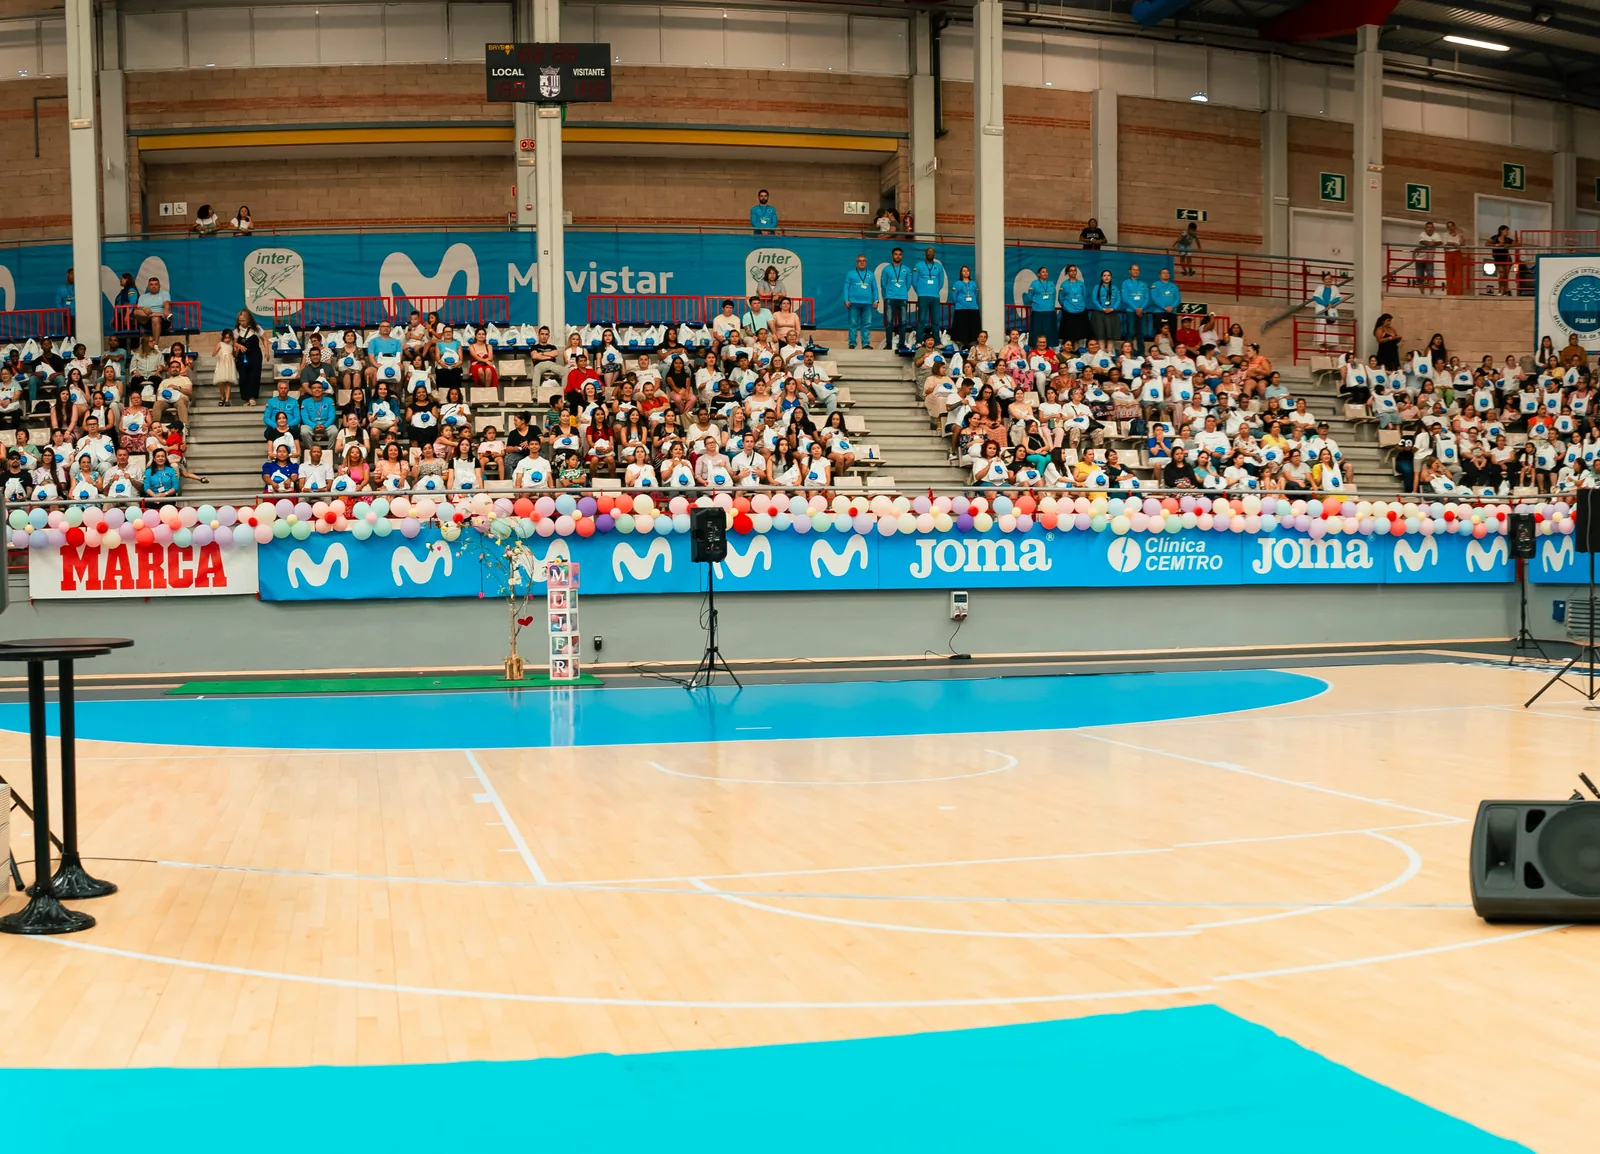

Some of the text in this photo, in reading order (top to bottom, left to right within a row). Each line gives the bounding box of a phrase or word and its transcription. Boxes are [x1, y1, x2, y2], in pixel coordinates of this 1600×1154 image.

[492, 68, 524, 76] LOCAL
[573, 68, 605, 76] VISITANTE
[257, 252, 292, 264] inter
[757, 251, 791, 264] inter
[508, 261, 674, 294] Mvistar
[1145, 536, 1206, 553] Clínica
[60, 541, 227, 591] MARCA
[1144, 555, 1224, 571] CEMTRO
